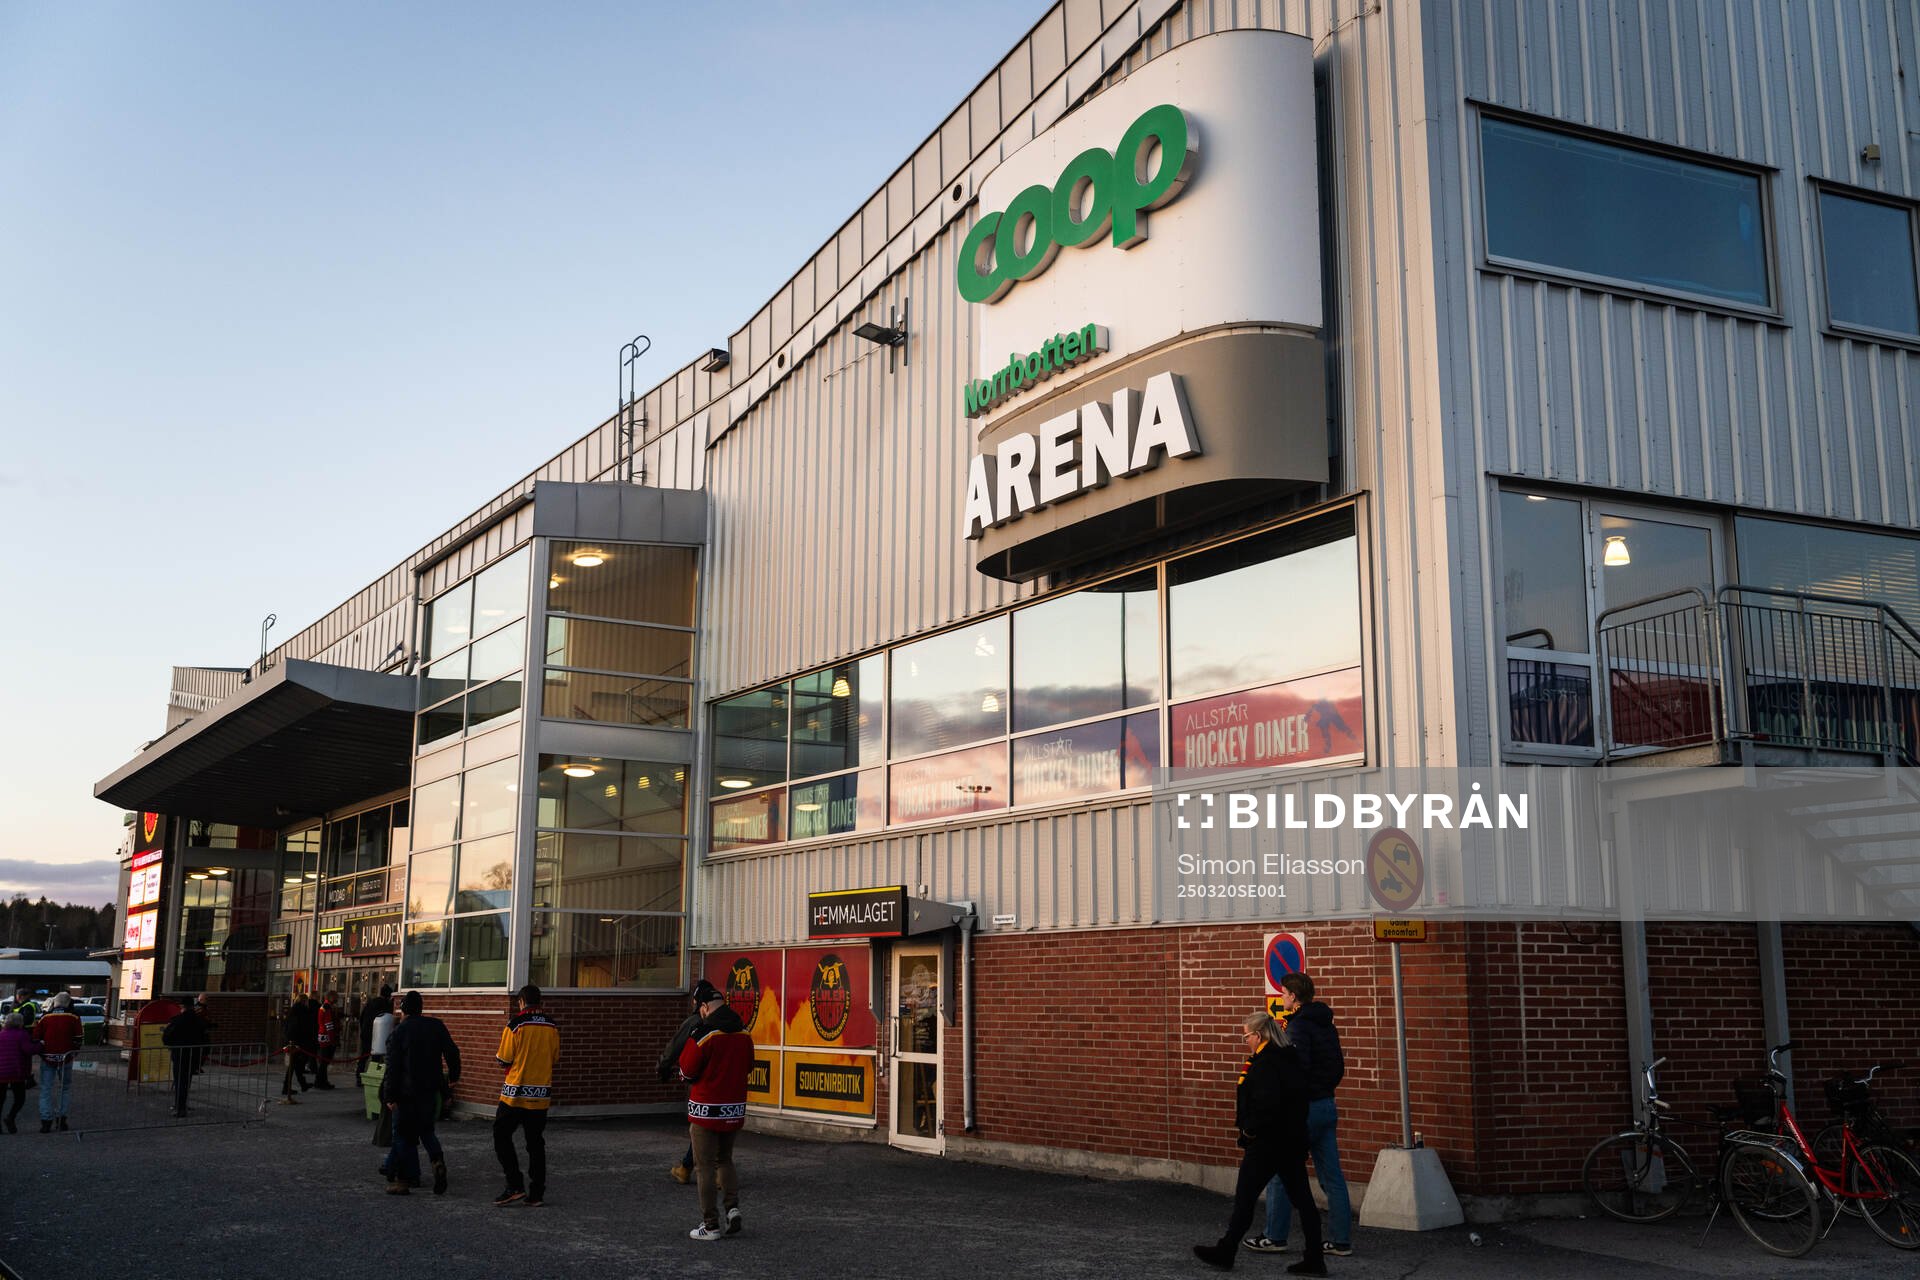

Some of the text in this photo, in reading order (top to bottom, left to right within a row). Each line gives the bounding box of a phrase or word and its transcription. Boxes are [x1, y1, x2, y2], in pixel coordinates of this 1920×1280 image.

[957, 103, 1191, 304] coop
[963, 321, 1099, 419] Norrbotten
[963, 370, 1198, 541] ARENA
[1185, 701, 1248, 731] ALLSTAR
[1024, 737, 1073, 761] ALLSTAR
[1185, 714, 1309, 770] HOCKEY DINER
[1023, 749, 1120, 797] HOCKEY DINER
[813, 901, 896, 926] HEMMALAGET
[361, 922, 403, 948] HUVUDEN
[502, 1084, 548, 1097] SAB SSAB
[799, 1070, 862, 1095] SOUVENIRBUTIK
[719, 1105, 745, 1117] SSAB
